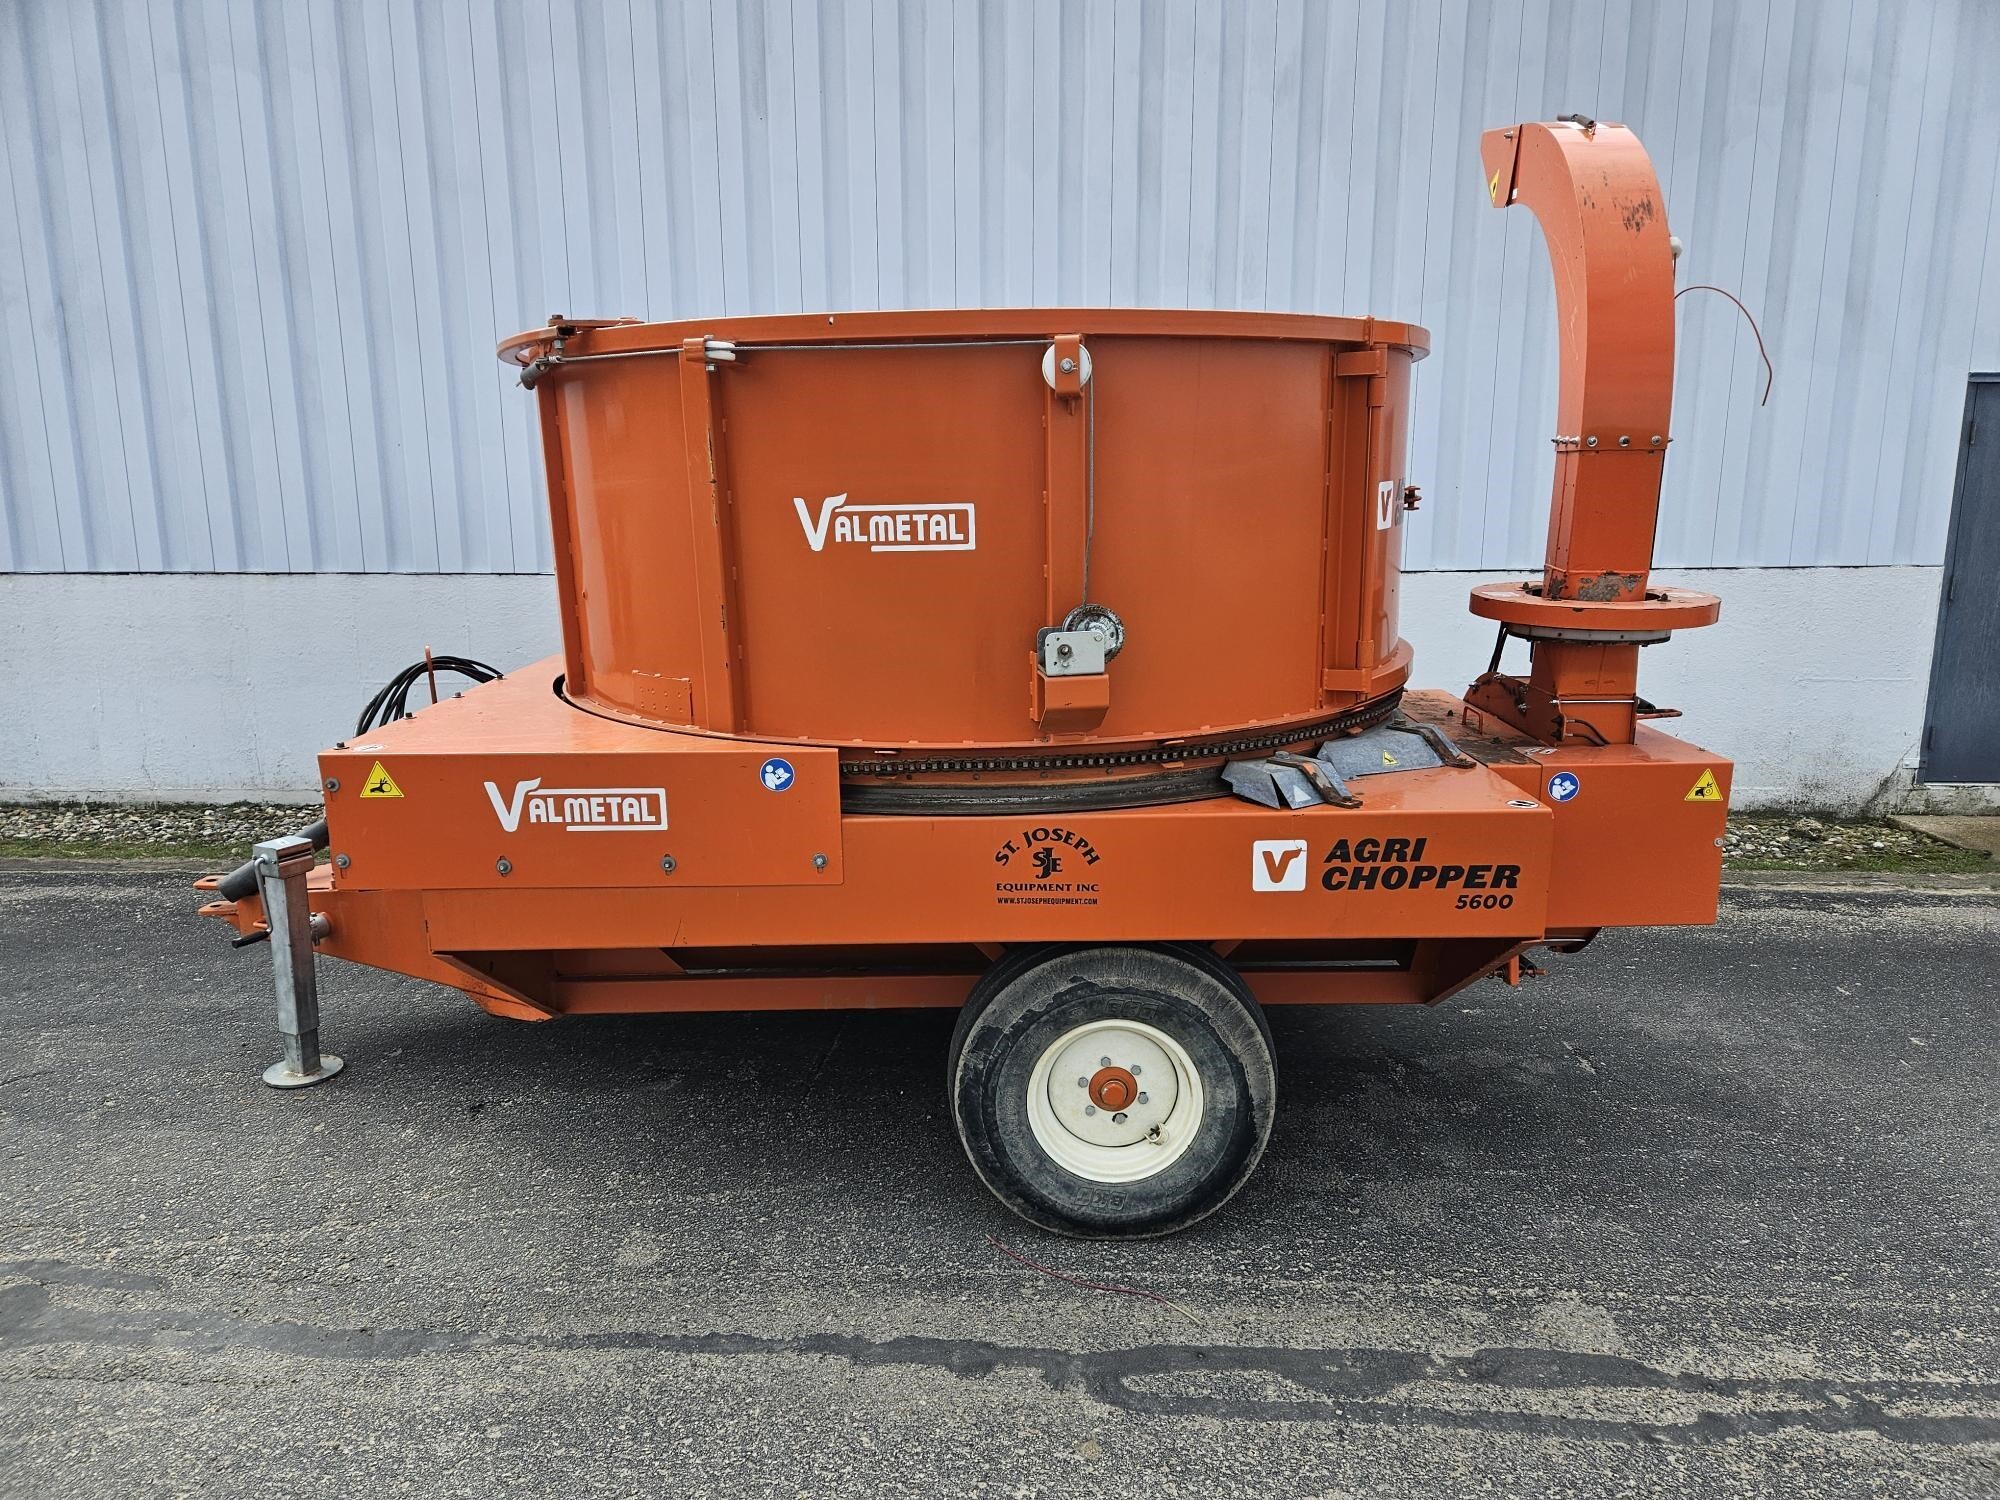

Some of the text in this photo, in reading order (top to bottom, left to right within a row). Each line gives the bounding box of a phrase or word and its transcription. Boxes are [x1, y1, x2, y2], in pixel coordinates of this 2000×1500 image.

[793, 493, 966, 552] VALMETAL
[484, 777, 657, 833] VALMETAL
[994, 827, 1101, 867] ST. JOSEPH
[1323, 837, 1428, 864] AGRI
[996, 883, 1100, 893] EQUIPMENT INC
[1321, 864, 1522, 891] CHOPPER
[997, 897, 1098, 905] WWW.STJOSEPHEQUIPMENT.COM
[1454, 894, 1514, 910] 5600
